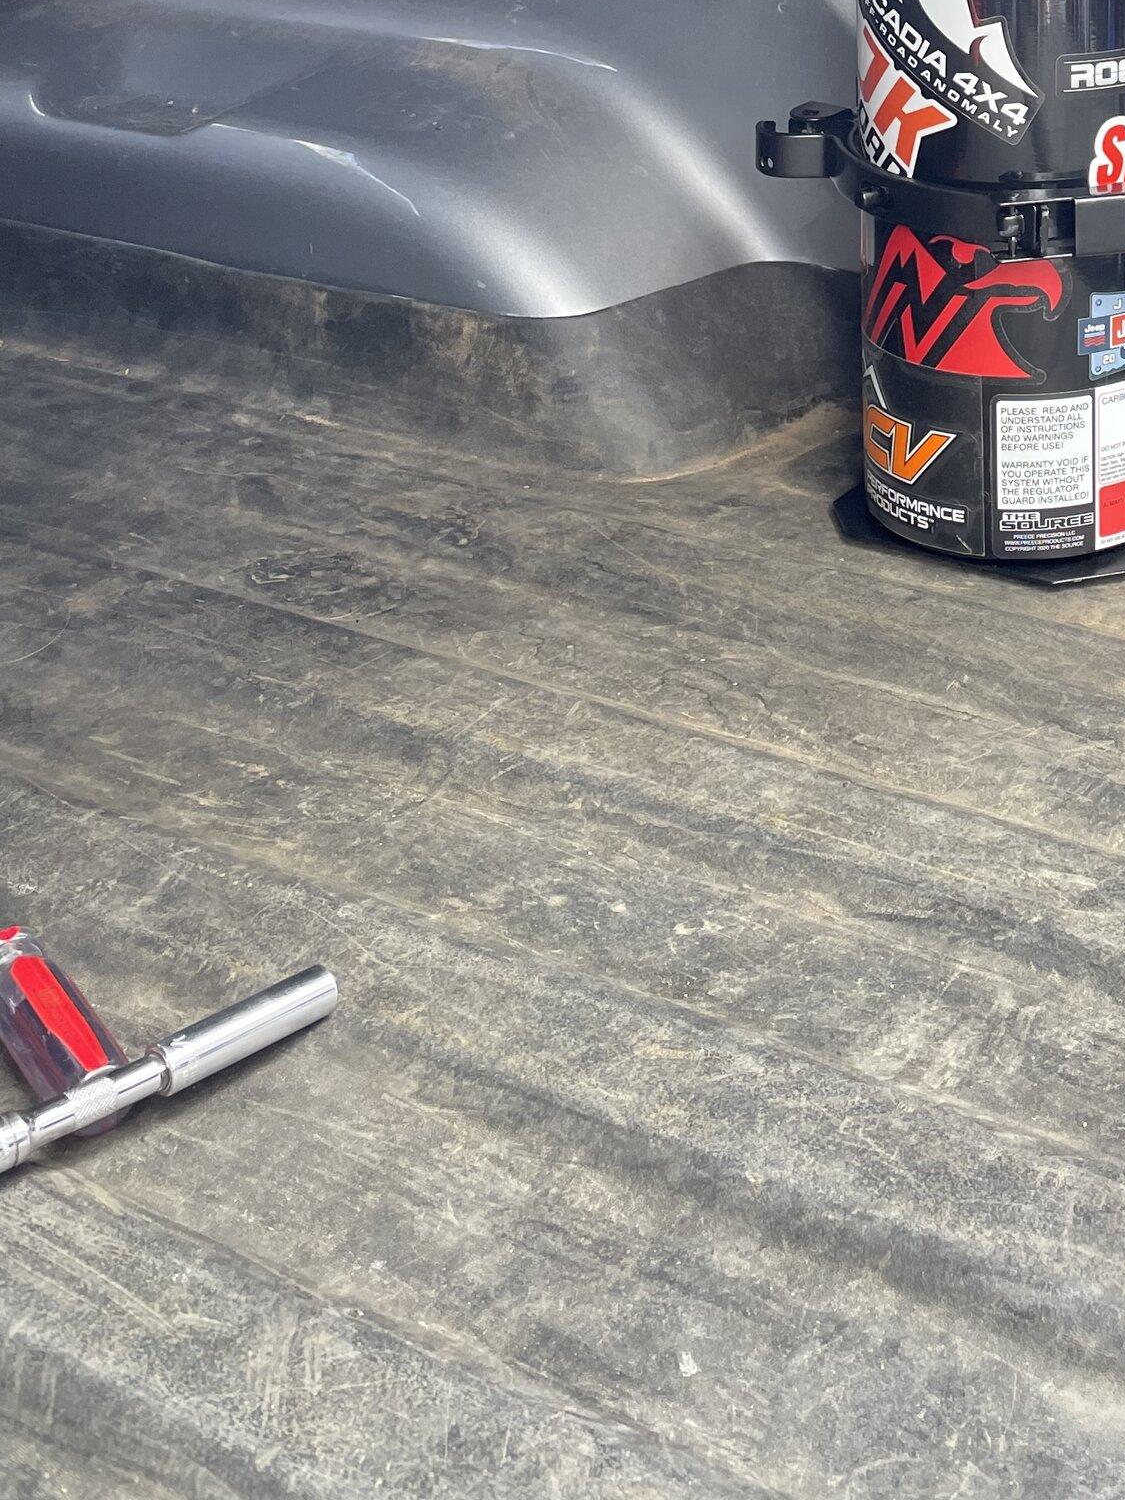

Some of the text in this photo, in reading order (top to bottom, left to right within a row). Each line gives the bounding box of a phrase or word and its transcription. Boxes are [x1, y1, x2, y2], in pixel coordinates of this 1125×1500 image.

[920, 69, 1019, 138] ANOMALY
[952, 72, 1029, 126] 4X4
[1084, 323, 1106, 333] Jeep
[1102, 352, 1117, 365] 20
[1001, 402, 1089, 416] PLEASE READ AND
[1001, 412, 1083, 425] UNDERSTAND ALL
[1001, 421, 1086, 434] OF INSTRUCTIONS
[1001, 431, 1074, 442] AND WARNINGS
[1001, 441, 1064, 451] BEFORE USE!
[1001, 455, 1089, 469] WARRANTY VOID IF
[1001, 464, 1090, 479] YOU OPERATE THIS
[1001, 474, 1085, 487] SYSTEM WITHOUT
[867, 468, 966, 523] PERFORMANCE
[1001, 484, 1079, 496] THE REGULATOR
[1001, 496, 1036, 505] GUARD
[1038, 491, 1089, 504] INSTALLED!
[1001, 513, 1093, 530] SOURCE
[1004, 512, 1039, 521] THE
[1061, 540, 1085, 549] SOURCE
